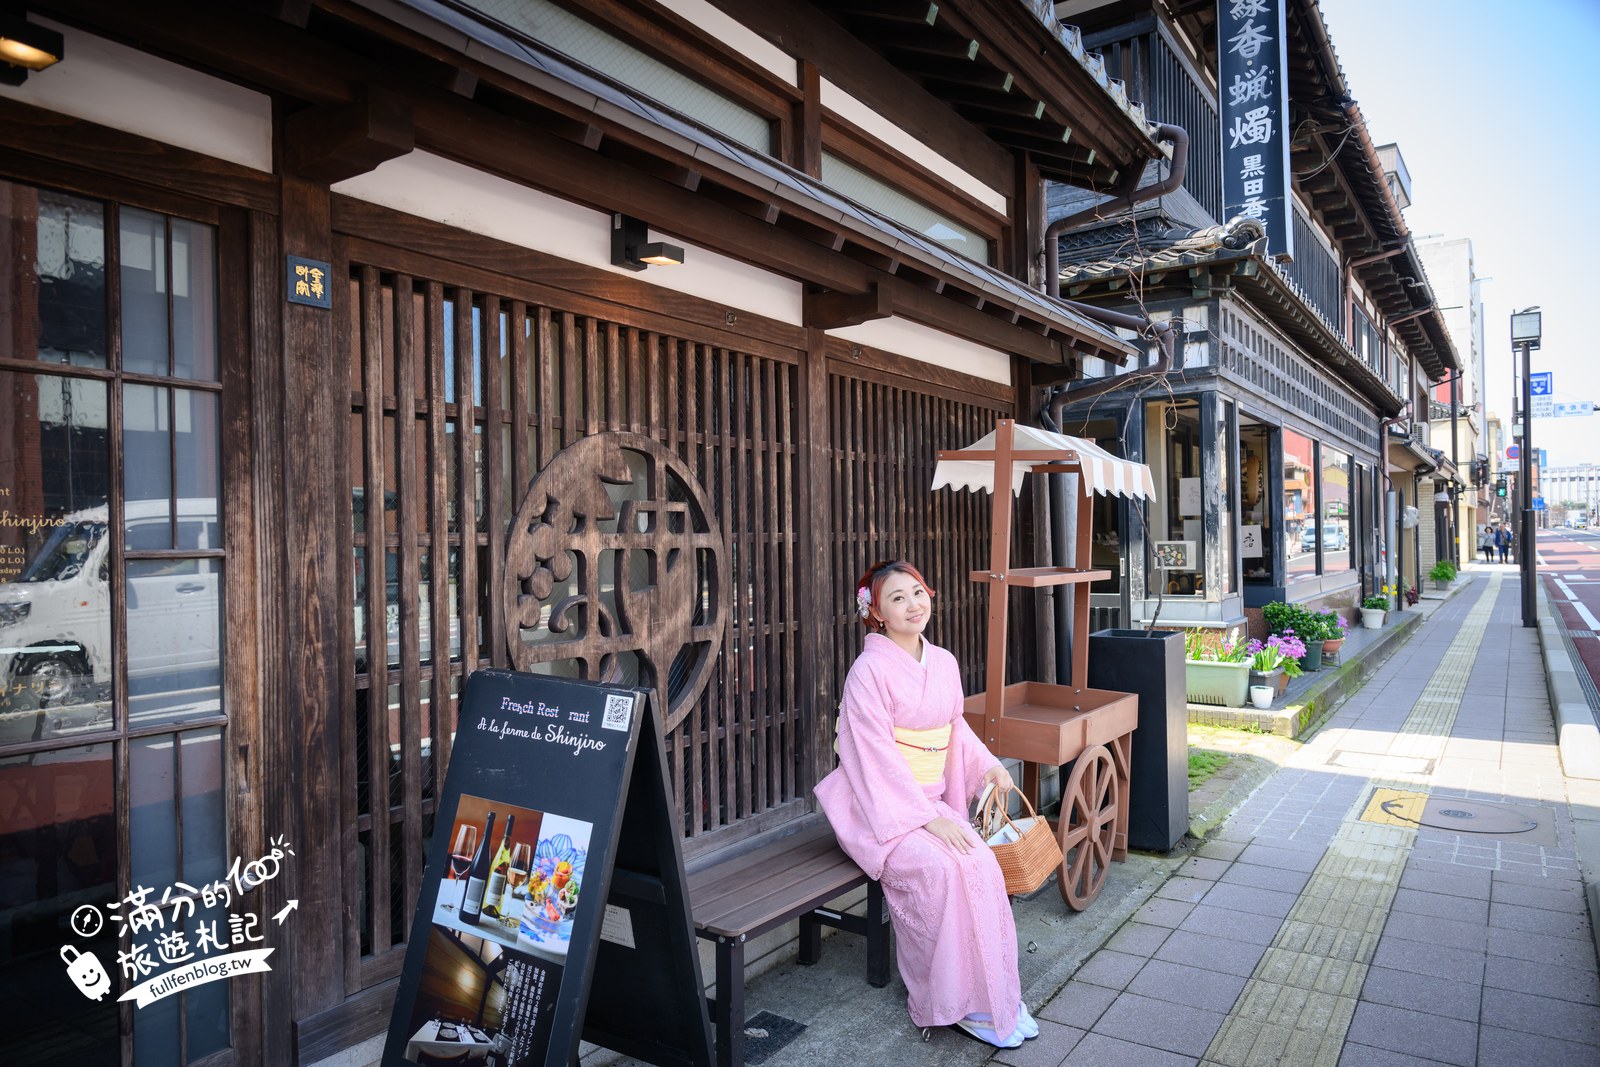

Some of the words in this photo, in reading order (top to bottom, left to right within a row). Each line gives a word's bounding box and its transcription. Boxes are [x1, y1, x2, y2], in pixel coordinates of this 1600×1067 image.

[1238, 154, 1270, 237] 黒田香
[0, 510, 65, 535] hinjiro
[501, 697, 534, 714] French
[488, 719, 499, 733] la
[499, 721, 530, 739] ferme
[531, 728, 543, 741] de
[545, 724, 606, 756] Shinjiro
